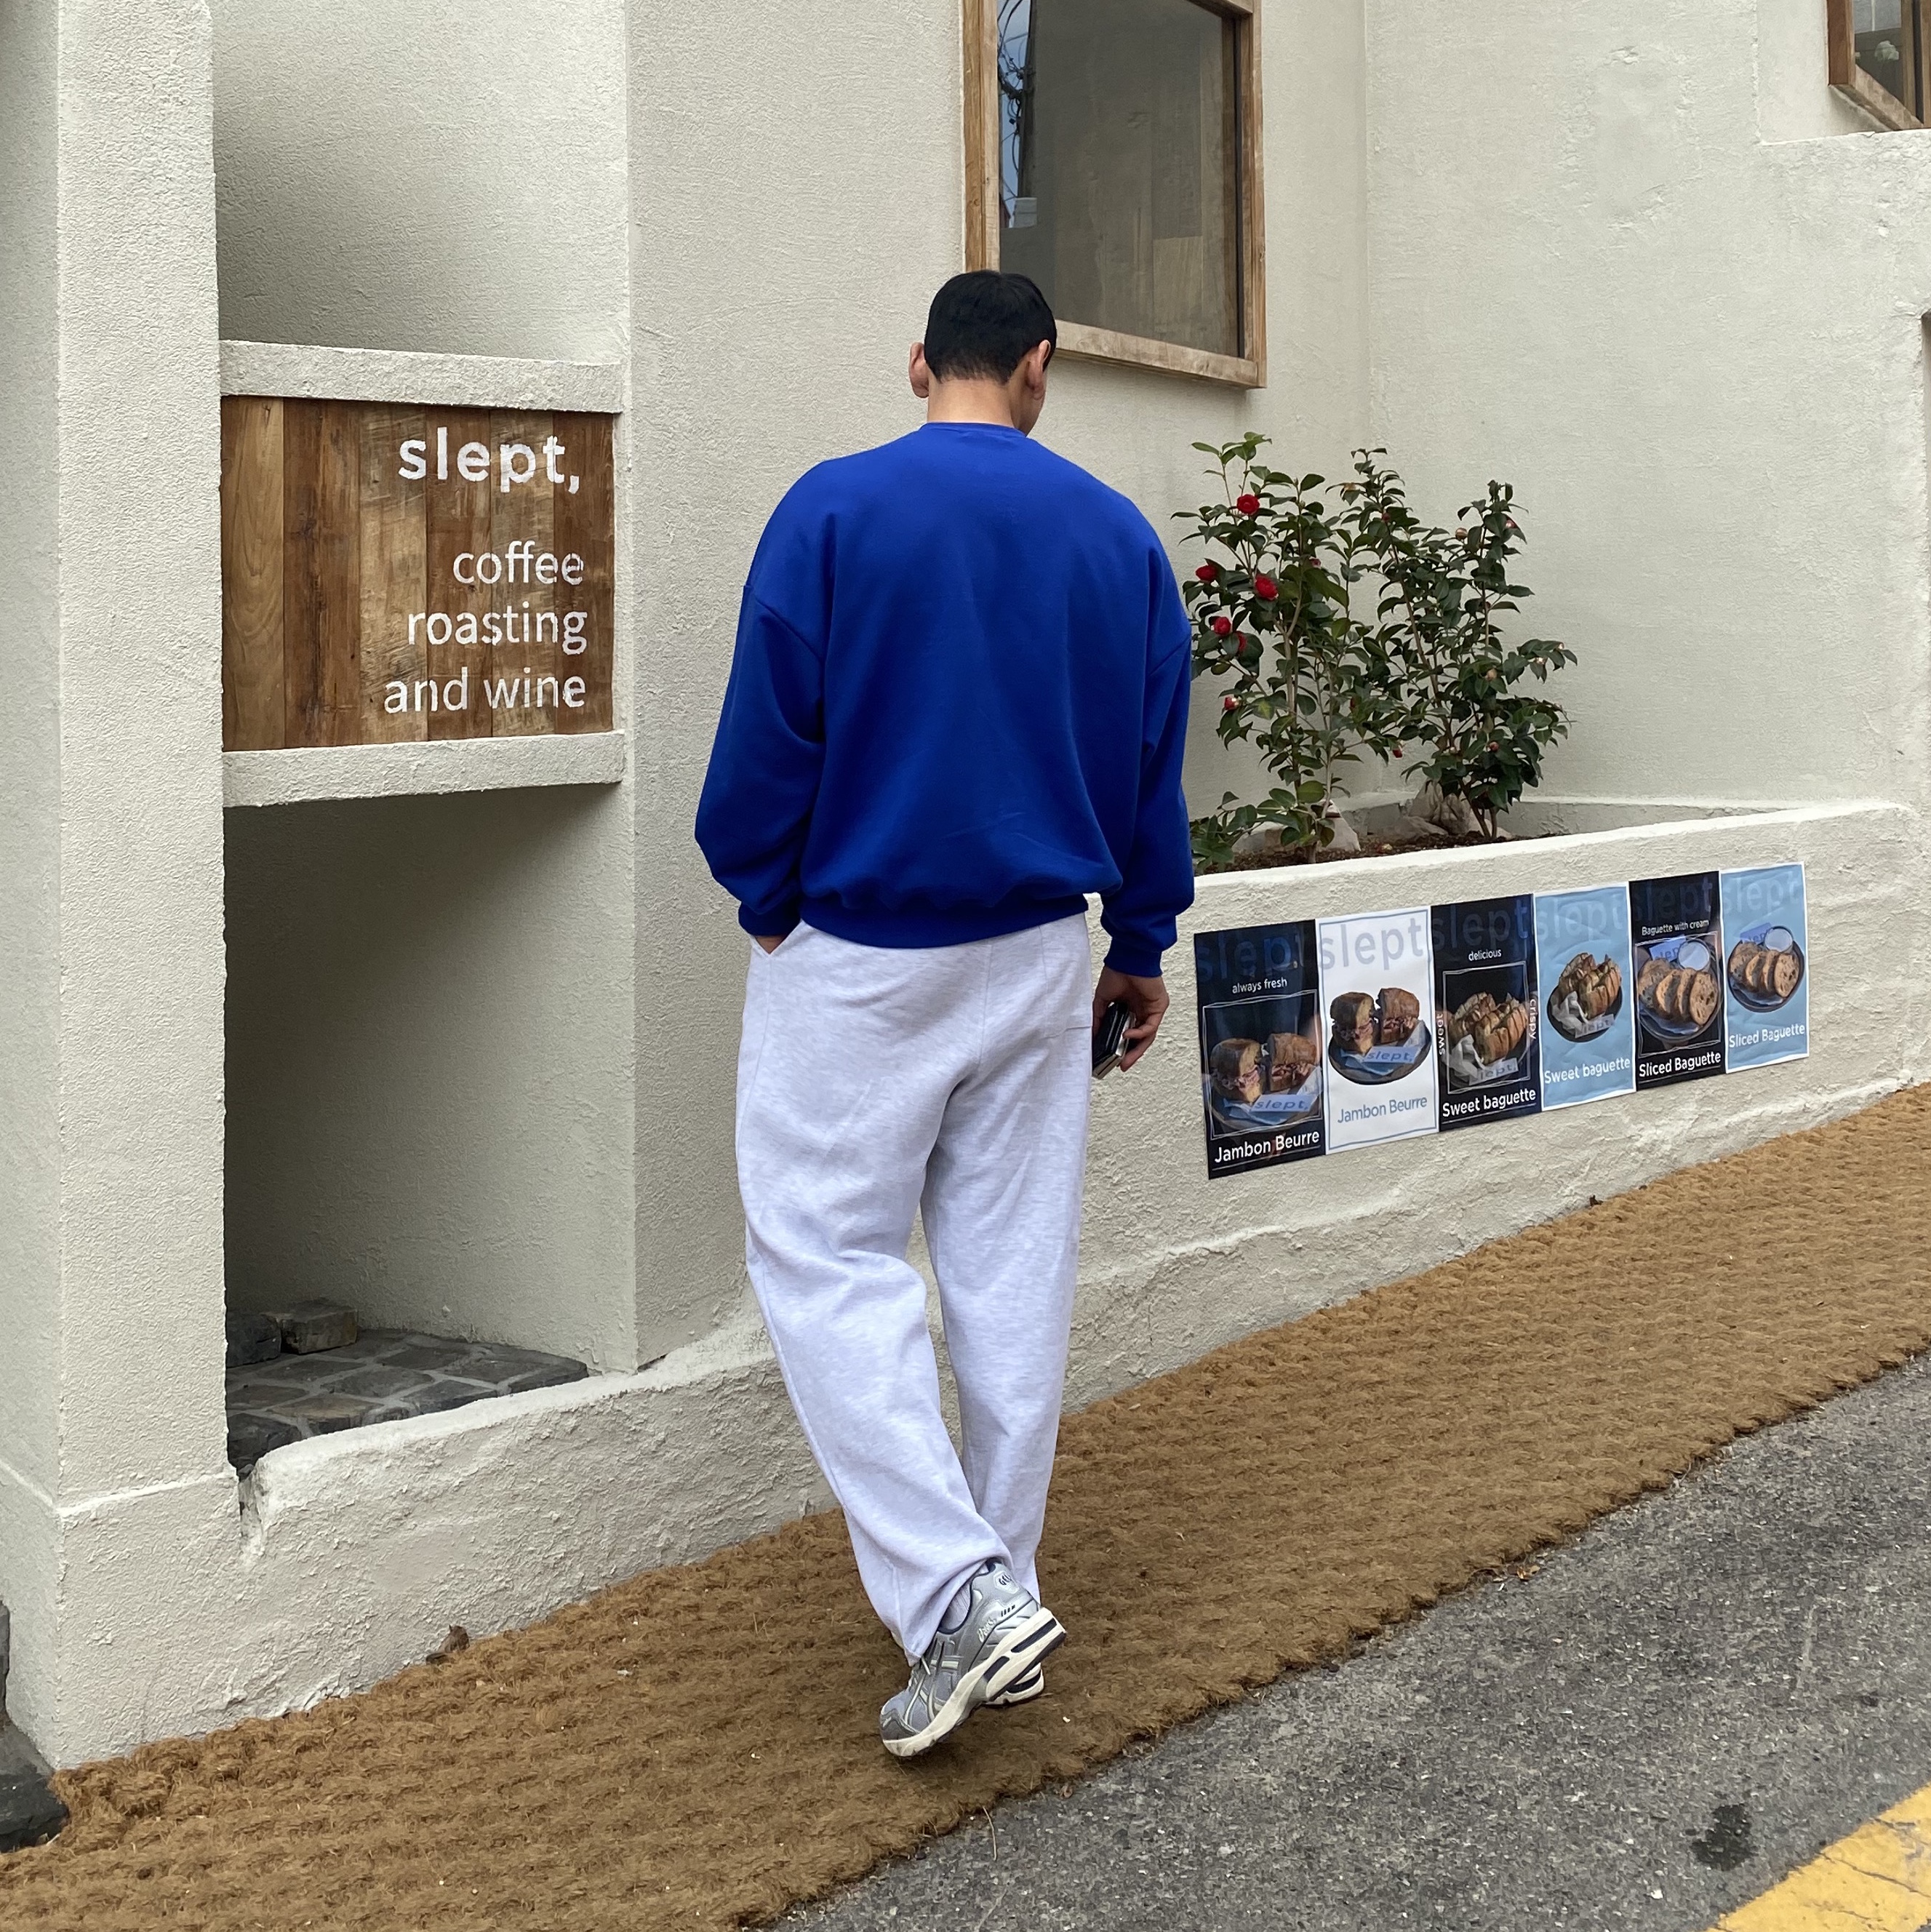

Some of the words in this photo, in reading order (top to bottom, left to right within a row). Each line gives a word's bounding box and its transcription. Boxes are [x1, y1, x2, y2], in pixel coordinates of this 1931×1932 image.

[399, 426, 580, 494] slept,
[453, 540, 584, 585] coffee
[408, 601, 588, 655] roasting
[385, 667, 468, 714] and
[484, 667, 586, 709] wine
[1642, 922, 1674, 936] Baguette
[1674, 921, 1688, 932] with
[1690, 919, 1709, 930] cream
[1468, 948, 1502, 961] delicious
[1231, 981, 1262, 994] always
[1263, 976, 1287, 989] fresh
[1436, 1013, 1445, 1055] sweet
[1529, 999, 1538, 1039] crispy
[1729, 1031, 1759, 1048] Sliced
[1762, 1023, 1805, 1042] Baguette
[1544, 1064, 1580, 1084] Sweet
[1583, 1057, 1631, 1079] baguette
[1639, 1058, 1672, 1077] Sliced
[1674, 1051, 1721, 1071] Baguette
[1337, 1101, 1386, 1124] Jambon
[1389, 1096, 1428, 1116] Beurre
[1442, 1095, 1480, 1117] Sweet
[1483, 1087, 1536, 1112] baguette
[1215, 1141, 1271, 1164] Jambon
[1275, 1130, 1320, 1152] Beurre
